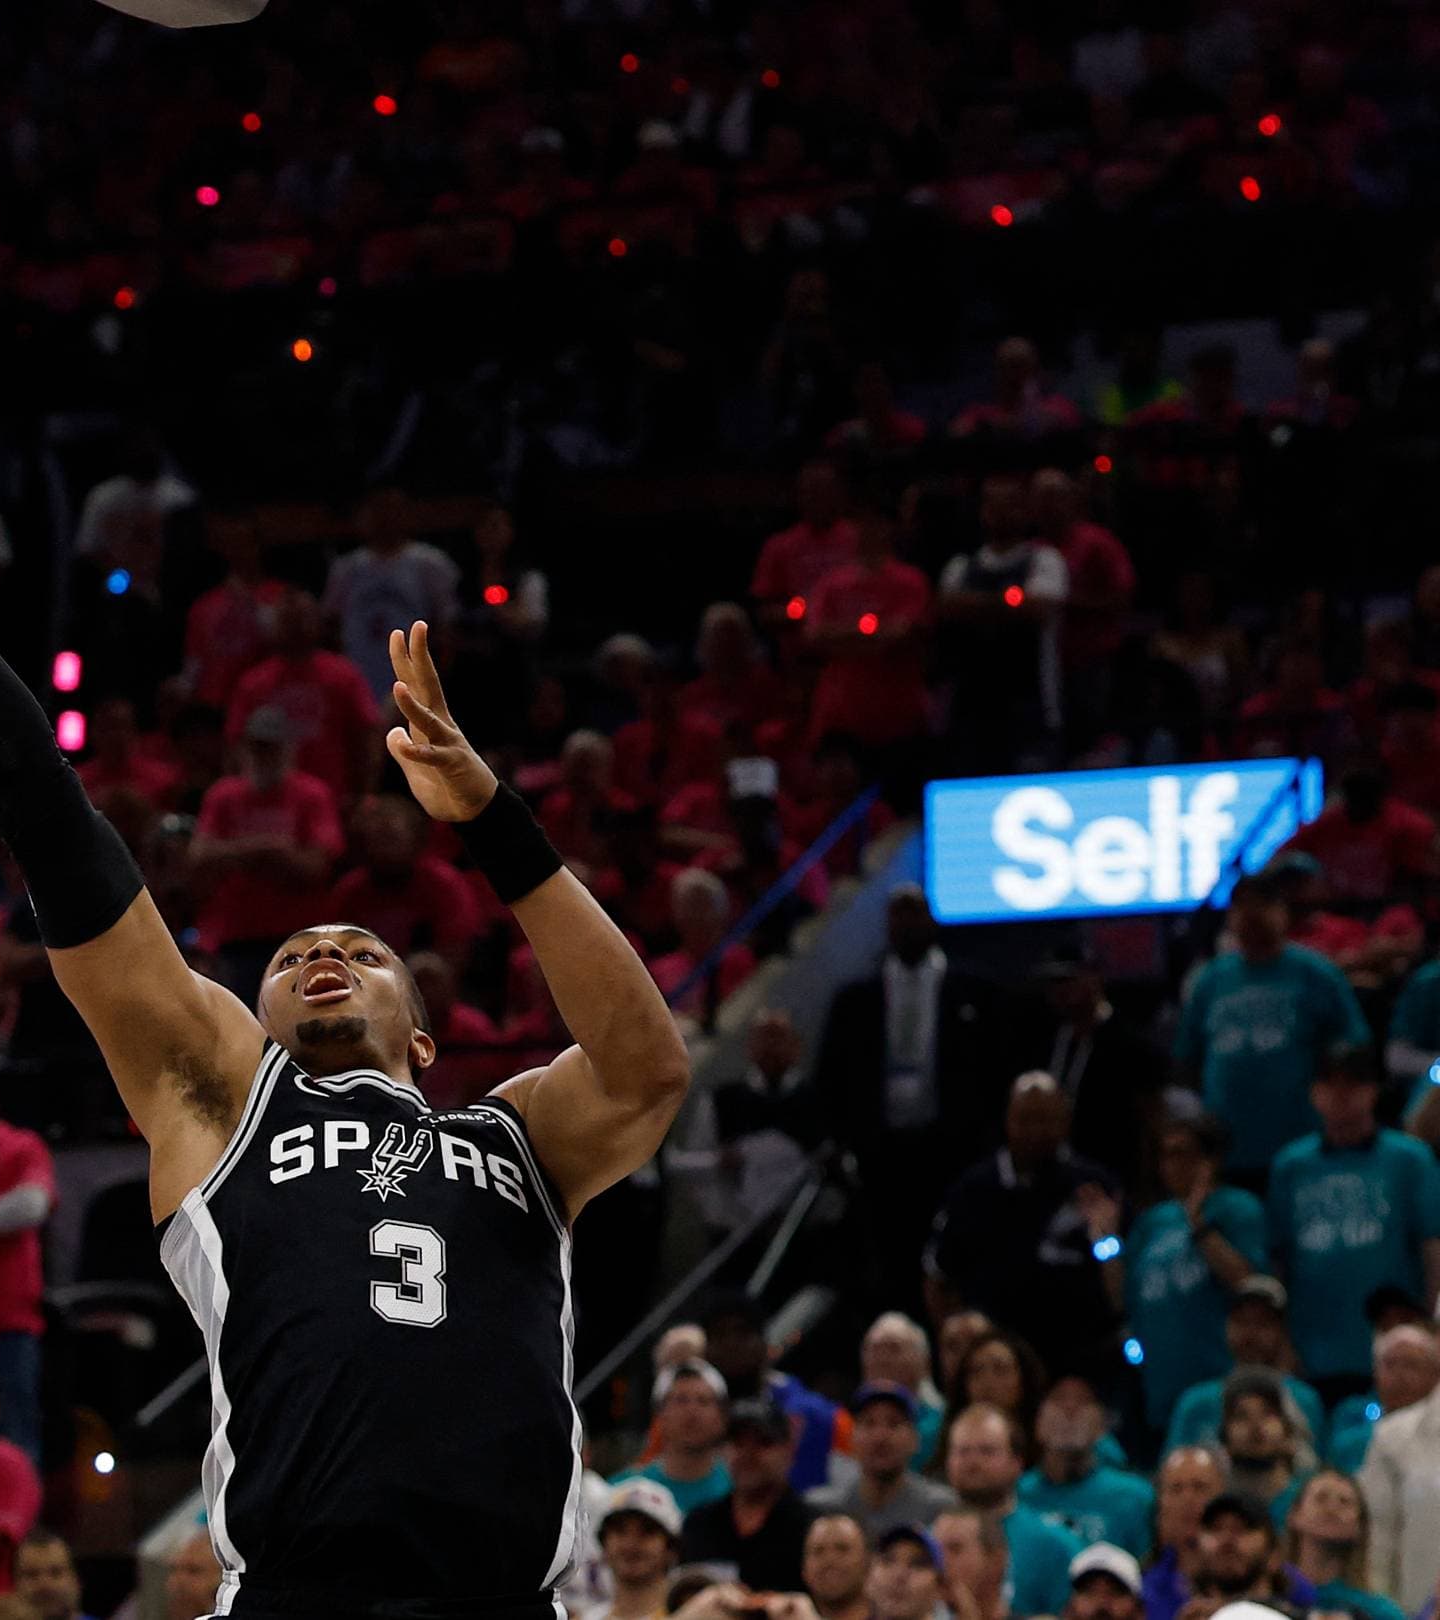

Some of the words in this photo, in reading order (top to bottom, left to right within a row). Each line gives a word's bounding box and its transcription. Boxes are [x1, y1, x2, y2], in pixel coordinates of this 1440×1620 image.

[991, 771, 1239, 912] Self
[269, 1120, 529, 1213] SPURS
[369, 1219, 447, 1328] 3
